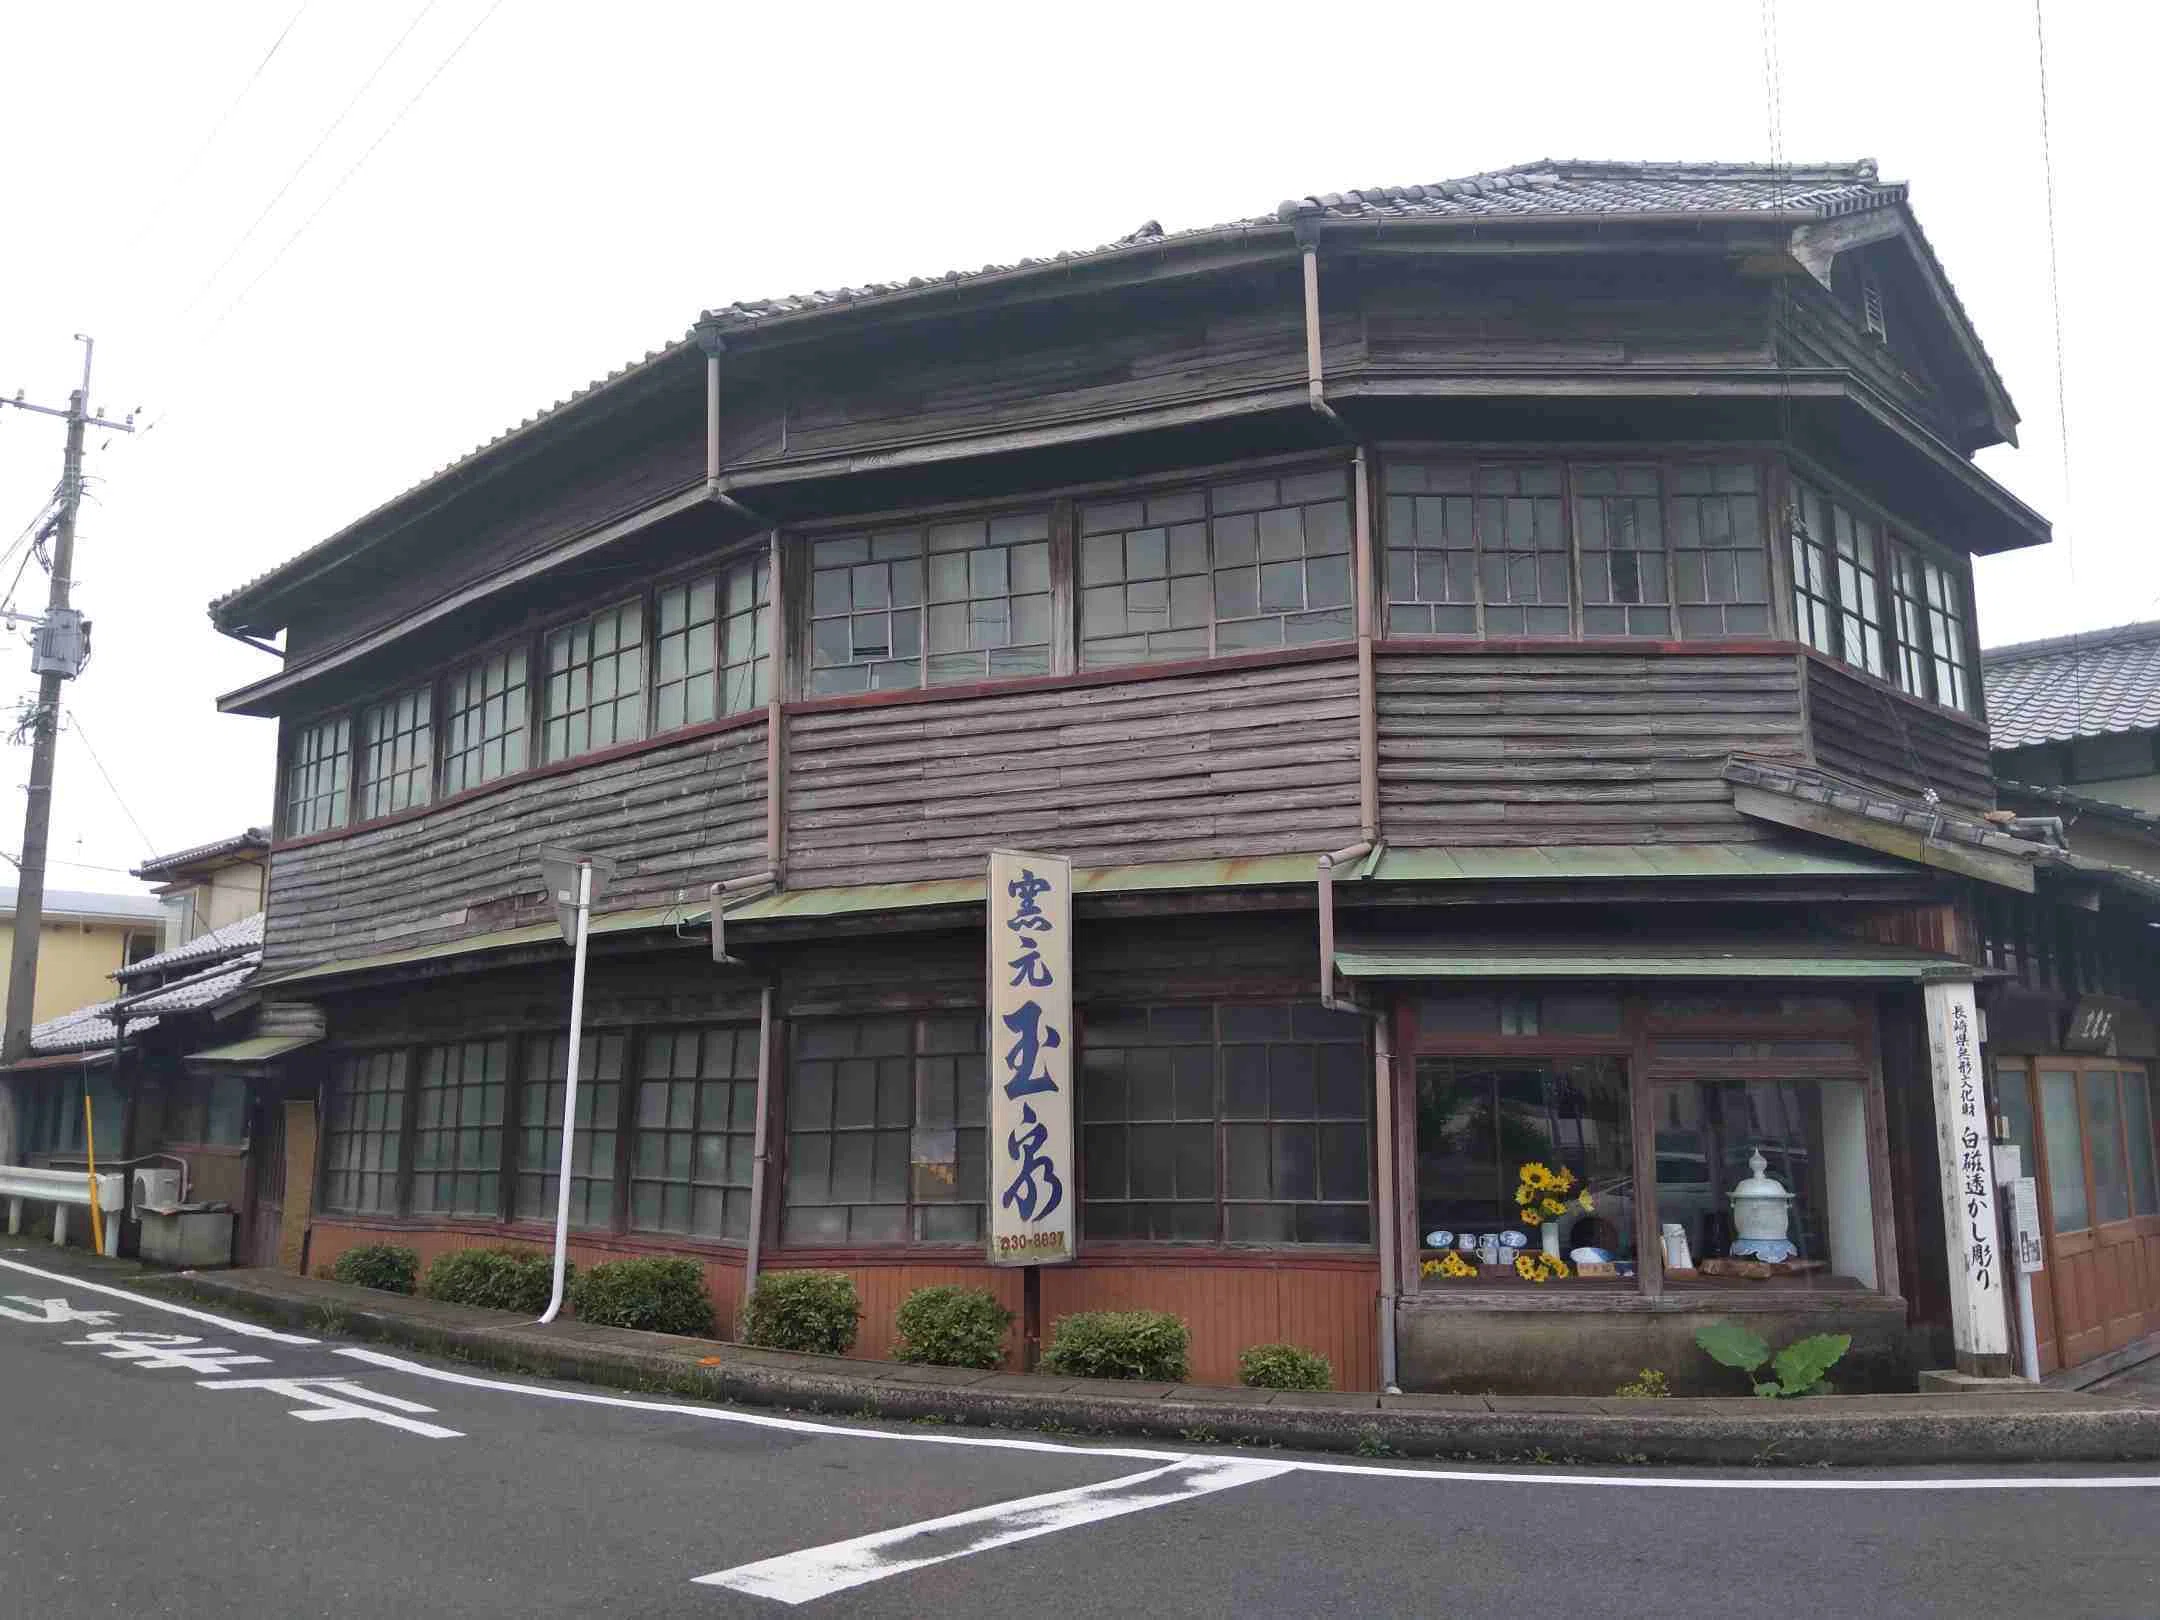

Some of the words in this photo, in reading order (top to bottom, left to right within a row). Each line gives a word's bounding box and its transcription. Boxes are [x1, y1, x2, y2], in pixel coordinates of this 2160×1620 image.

[1962, 1127, 1993, 1290] 白磁透かし彫り
